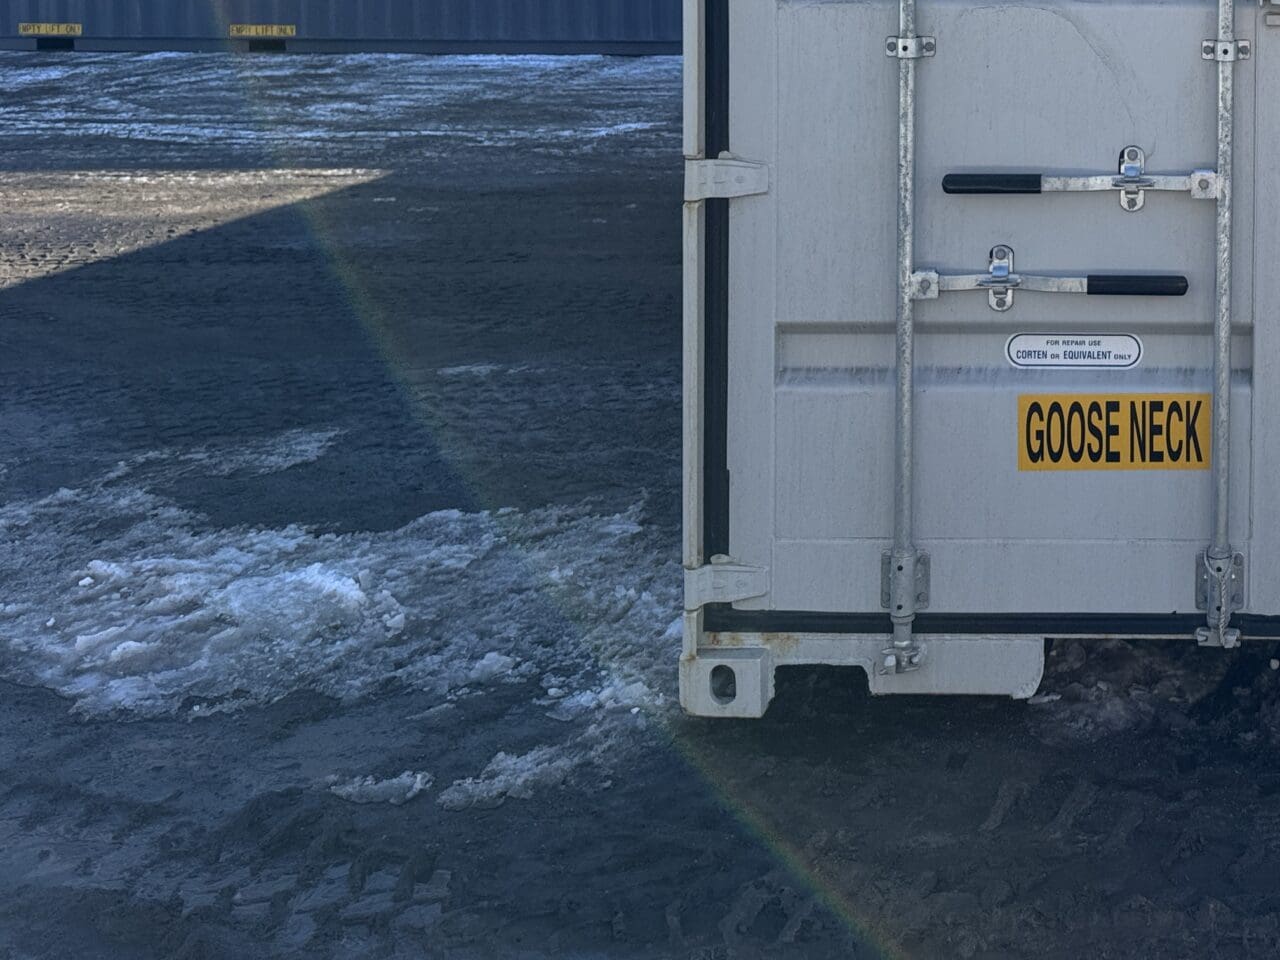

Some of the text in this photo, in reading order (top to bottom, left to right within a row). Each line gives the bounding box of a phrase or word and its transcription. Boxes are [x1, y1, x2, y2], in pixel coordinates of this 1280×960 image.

[1046, 339, 1101, 347] FOR REPAIR USE
[1016, 350, 1048, 360] CORTEN
[1063, 350, 1112, 360] EQUIVALENT
[1113, 353, 1132, 361] ONLY
[1026, 400, 1203, 463] GOOSE NECK
